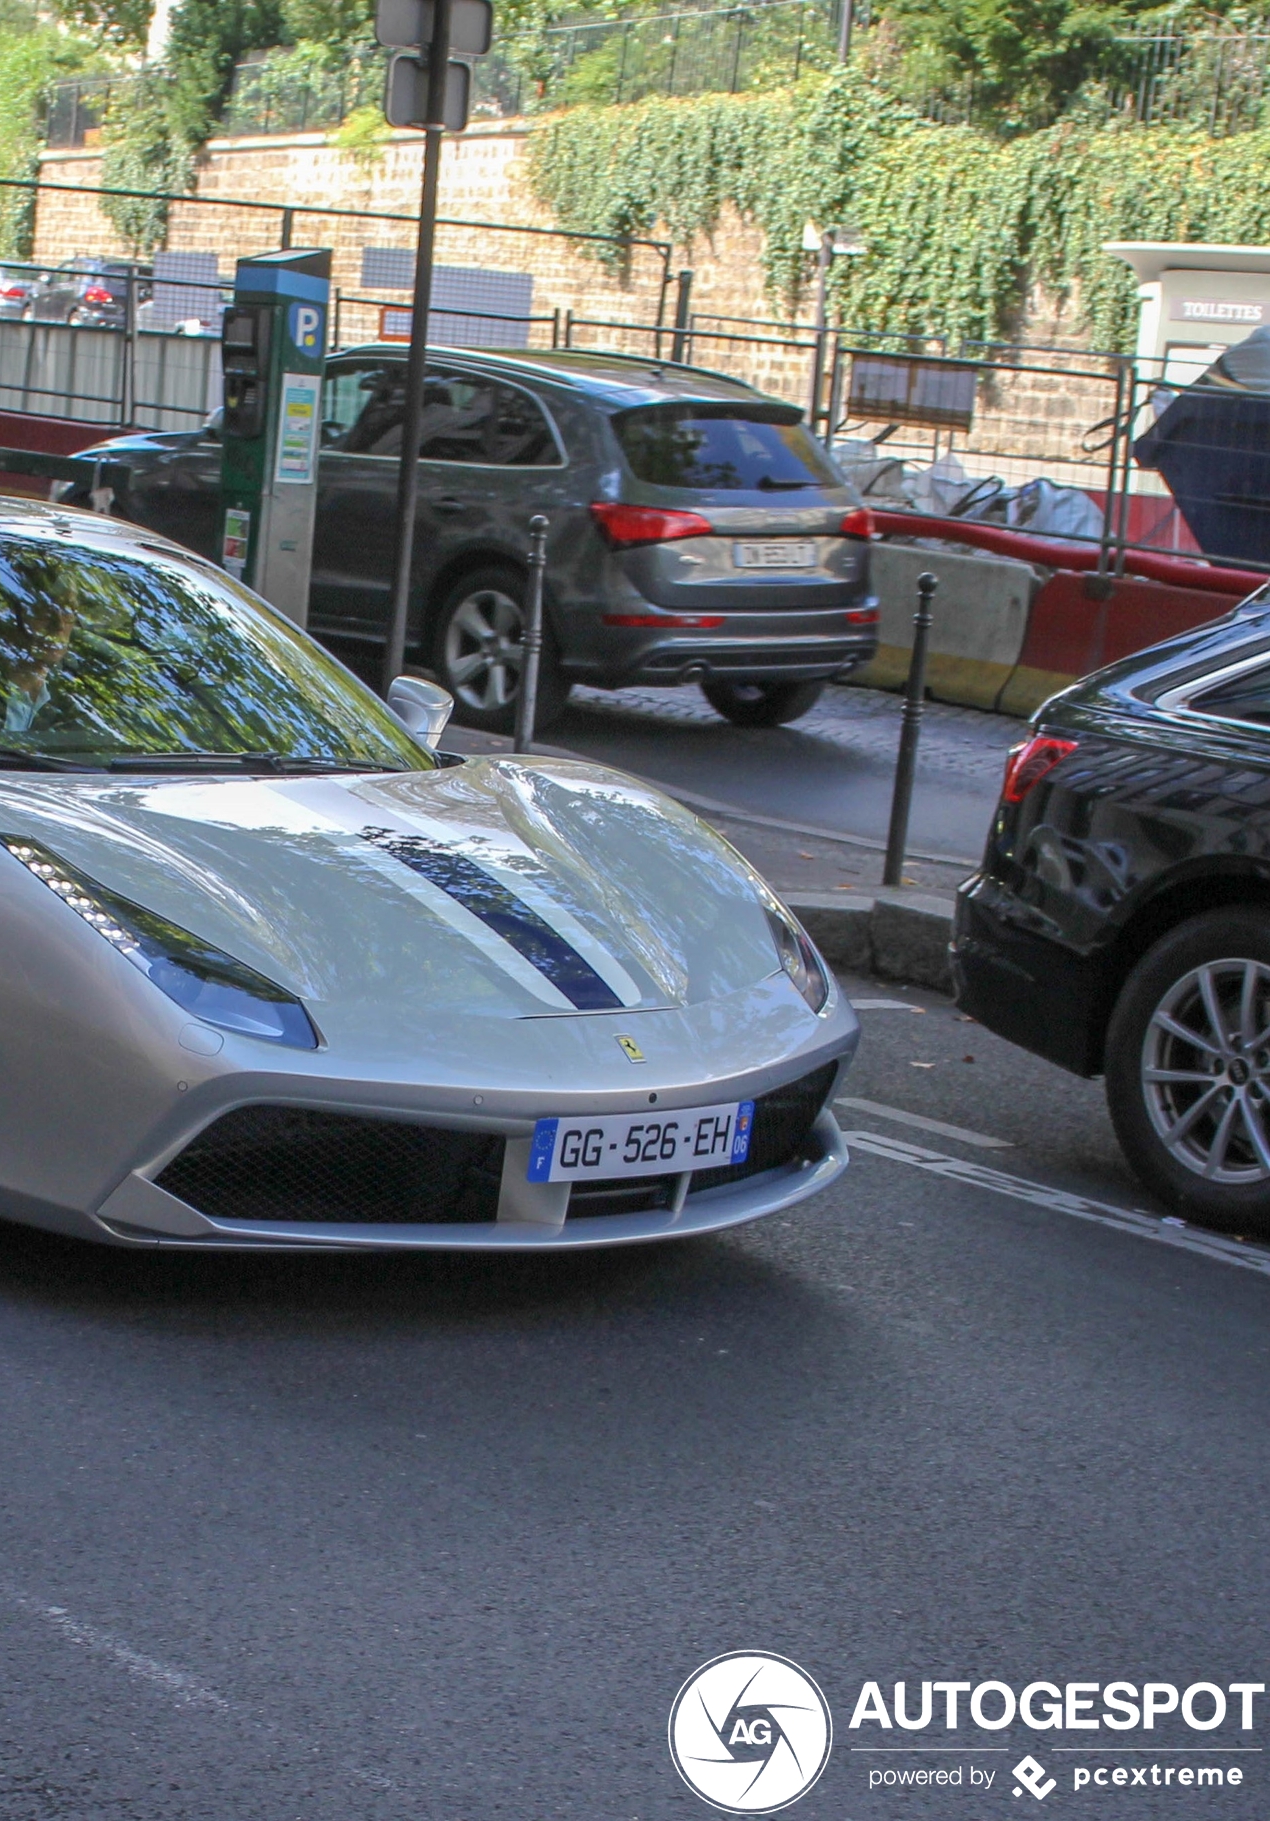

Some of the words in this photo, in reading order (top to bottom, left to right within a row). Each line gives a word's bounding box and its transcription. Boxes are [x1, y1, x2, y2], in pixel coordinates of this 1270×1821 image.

[1183, 301, 1263, 320] TOILETTES
[559, 1114, 732, 1168] GG-526-EH
[733, 1134, 748, 1155] 06
[536, 1156, 545, 1170] F
